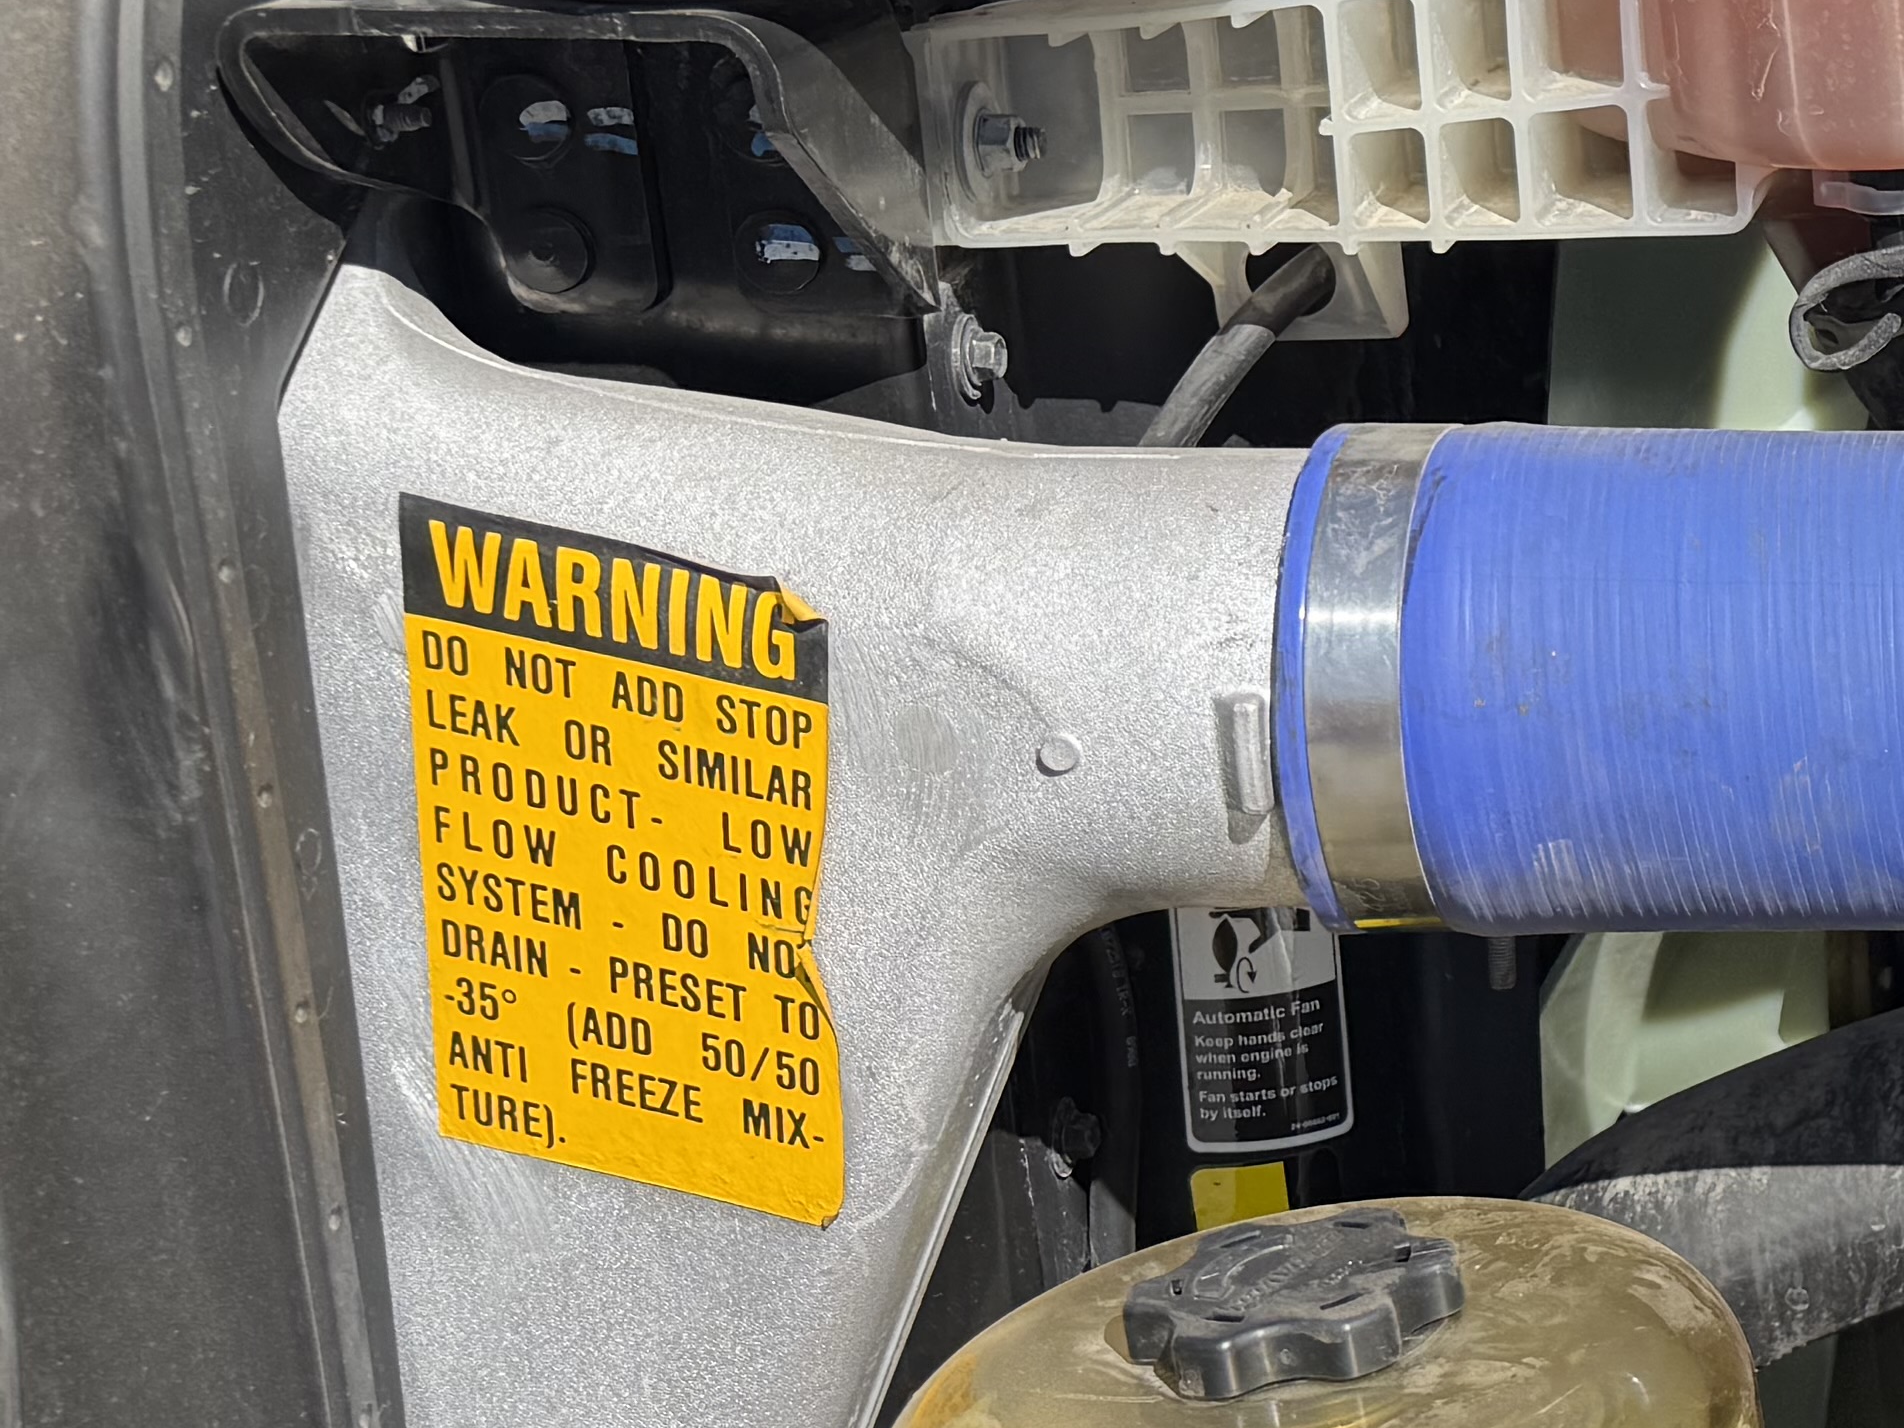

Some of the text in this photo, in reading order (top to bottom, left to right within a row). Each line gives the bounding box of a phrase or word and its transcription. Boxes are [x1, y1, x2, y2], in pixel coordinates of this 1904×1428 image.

[428, 520, 796, 680] WARNING
[422, 632, 813, 749] DO NOT ADD STOP
[426, 690, 812, 811] LEAK OR SIMILAR
[431, 749, 812, 866] PRODUCT- LOW
[434, 805, 811, 924] FLOW COOLING
[437, 865, 582, 931] SYSTEM
[662, 915, 708, 958] DO
[441, 920, 820, 1041] DRAIN PRESET TO
[1193, 998, 1320, 1025] Automatic Fan
[568, 1001, 652, 1056] (ADD
[702, 1034, 820, 1096] 50/50
[1194, 1022, 1324, 1049] Keep hands clear
[1196, 1042, 1309, 1064] when engine is
[1197, 1067, 1261, 1082] running.
[449, 1031, 824, 1150] ANTI FREEZE MIX-
[455, 1085, 566, 1148] TURE).
[1199, 1074, 1338, 1103] Fan starts or stops
[1200, 1105, 1266, 1121] by itself.
